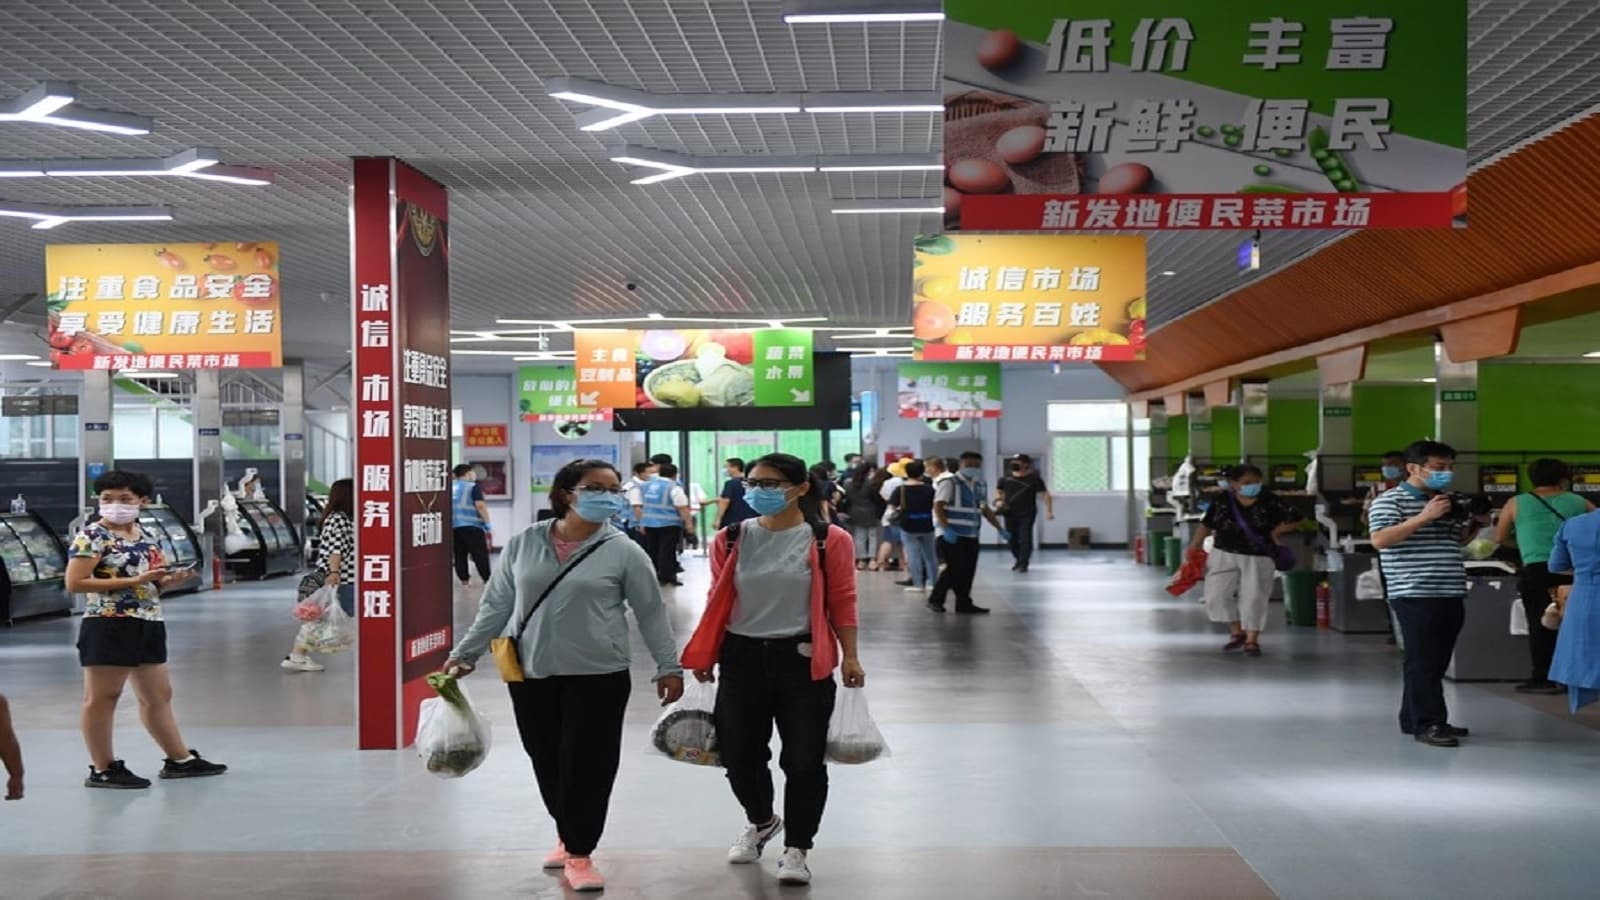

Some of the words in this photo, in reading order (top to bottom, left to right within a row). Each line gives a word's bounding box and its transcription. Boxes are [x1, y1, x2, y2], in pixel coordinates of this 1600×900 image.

[1046, 18, 1194, 72] 低价
[1243, 17, 1393, 70] 丰富
[1044, 99, 1197, 152] 新鲜
[1243, 99, 1391, 151] 便民
[1041, 198, 1371, 228] 新发地便民菜市场
[58, 274, 272, 300] 注重食品安全
[959, 266, 1101, 291] 诚信市场
[57, 310, 274, 336] 享受健康生活
[361, 284, 389, 347] 诚信
[958, 302, 1100, 326] 服务百姓
[93, 354, 240, 369] 新发地便民菜市场
[956, 345, 1103, 360] 新发地便民菜市场
[403, 348, 448, 388] 注重食品安全
[579, 368, 633, 382] 豆制品
[362, 374, 390, 437] 市场
[362, 465, 390, 527] 服务
[363, 555, 391, 617] 百姓
